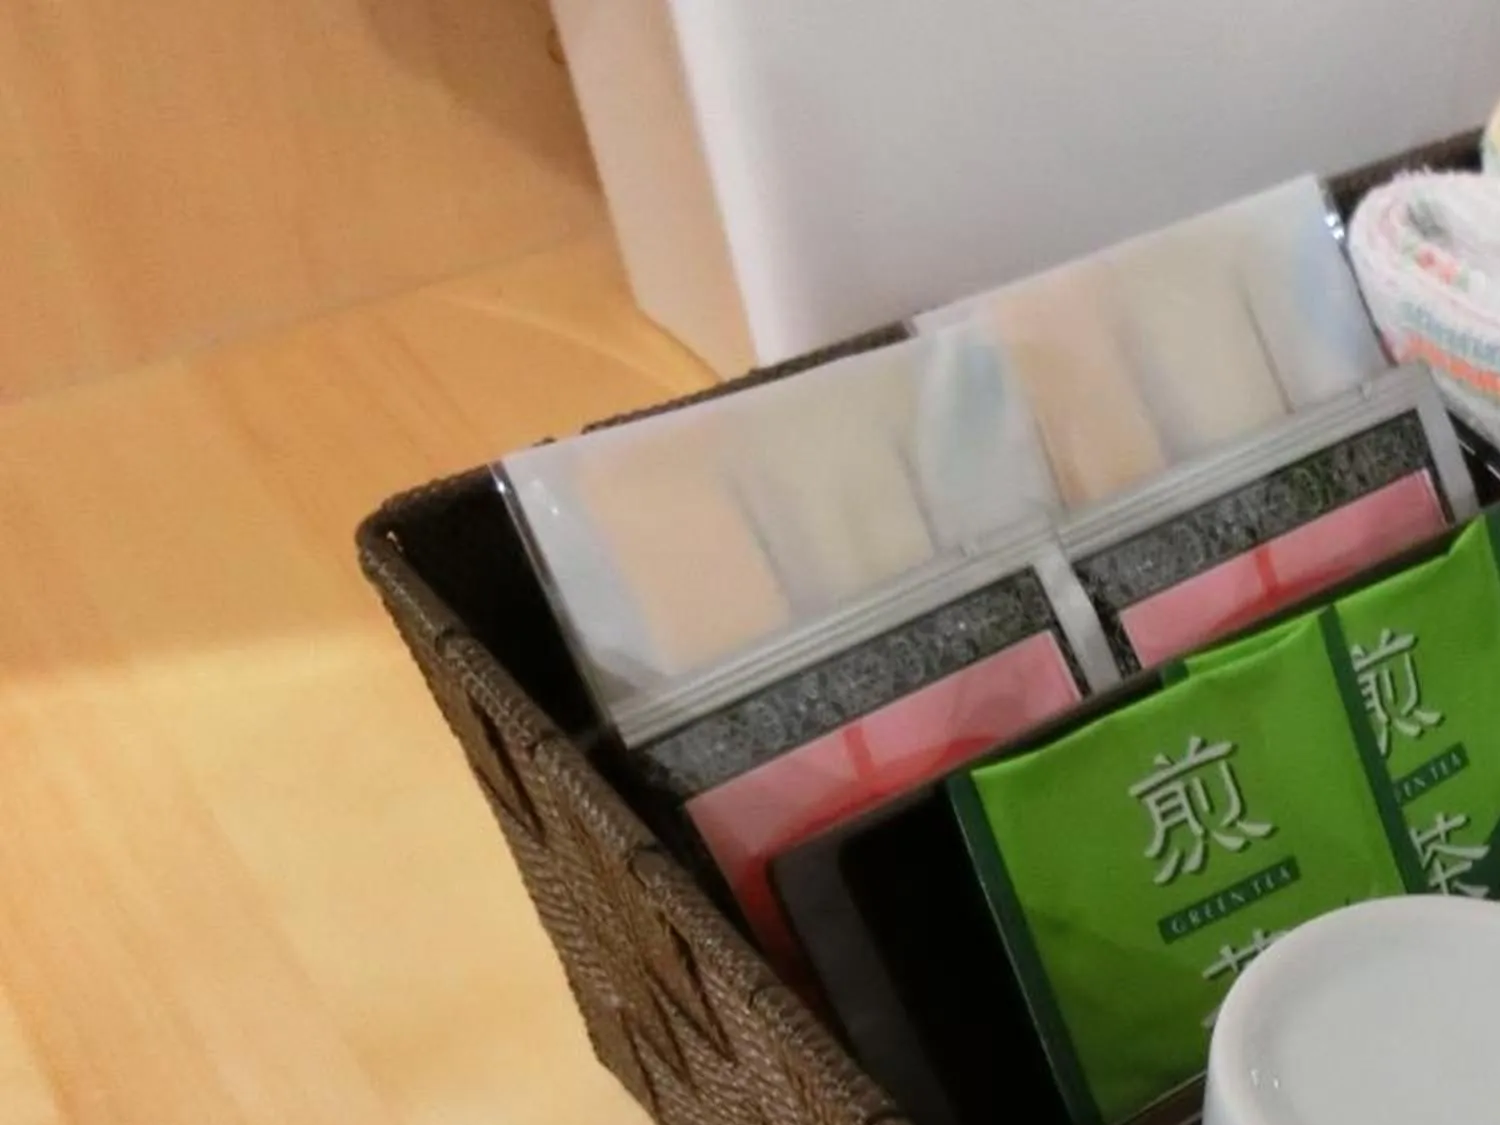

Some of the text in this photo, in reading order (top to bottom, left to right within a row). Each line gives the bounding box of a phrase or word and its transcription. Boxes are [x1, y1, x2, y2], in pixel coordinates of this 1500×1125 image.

[1128, 736, 1274, 884] 煎
[1171, 866, 1291, 933] GREEN TEA
